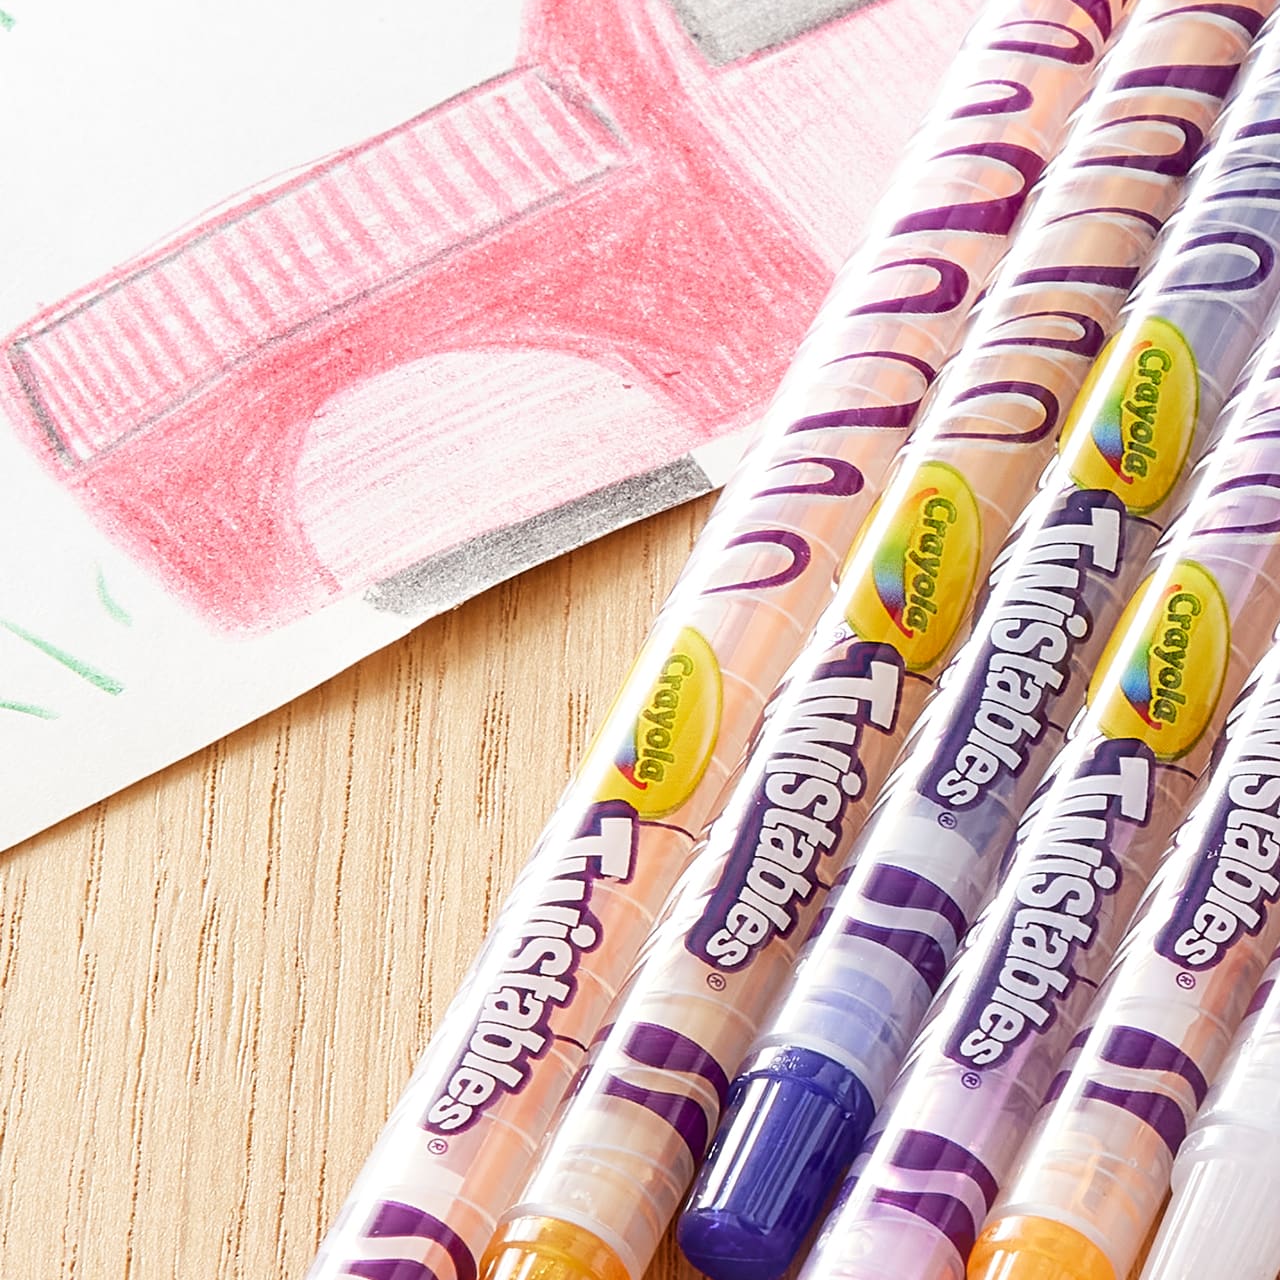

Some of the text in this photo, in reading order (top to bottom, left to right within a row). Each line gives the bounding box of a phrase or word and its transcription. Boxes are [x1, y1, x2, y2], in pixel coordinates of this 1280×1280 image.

[1121, 346, 1172, 480] Crayola
[903, 496, 957, 635] Crayola
[635, 652, 693, 784] Crayola
[935, 508, 1120, 807] Twistables
[1150, 589, 1202, 724] Crayola
[705, 659, 900, 968] Twistables
[960, 756, 1149, 1066] Twistables
